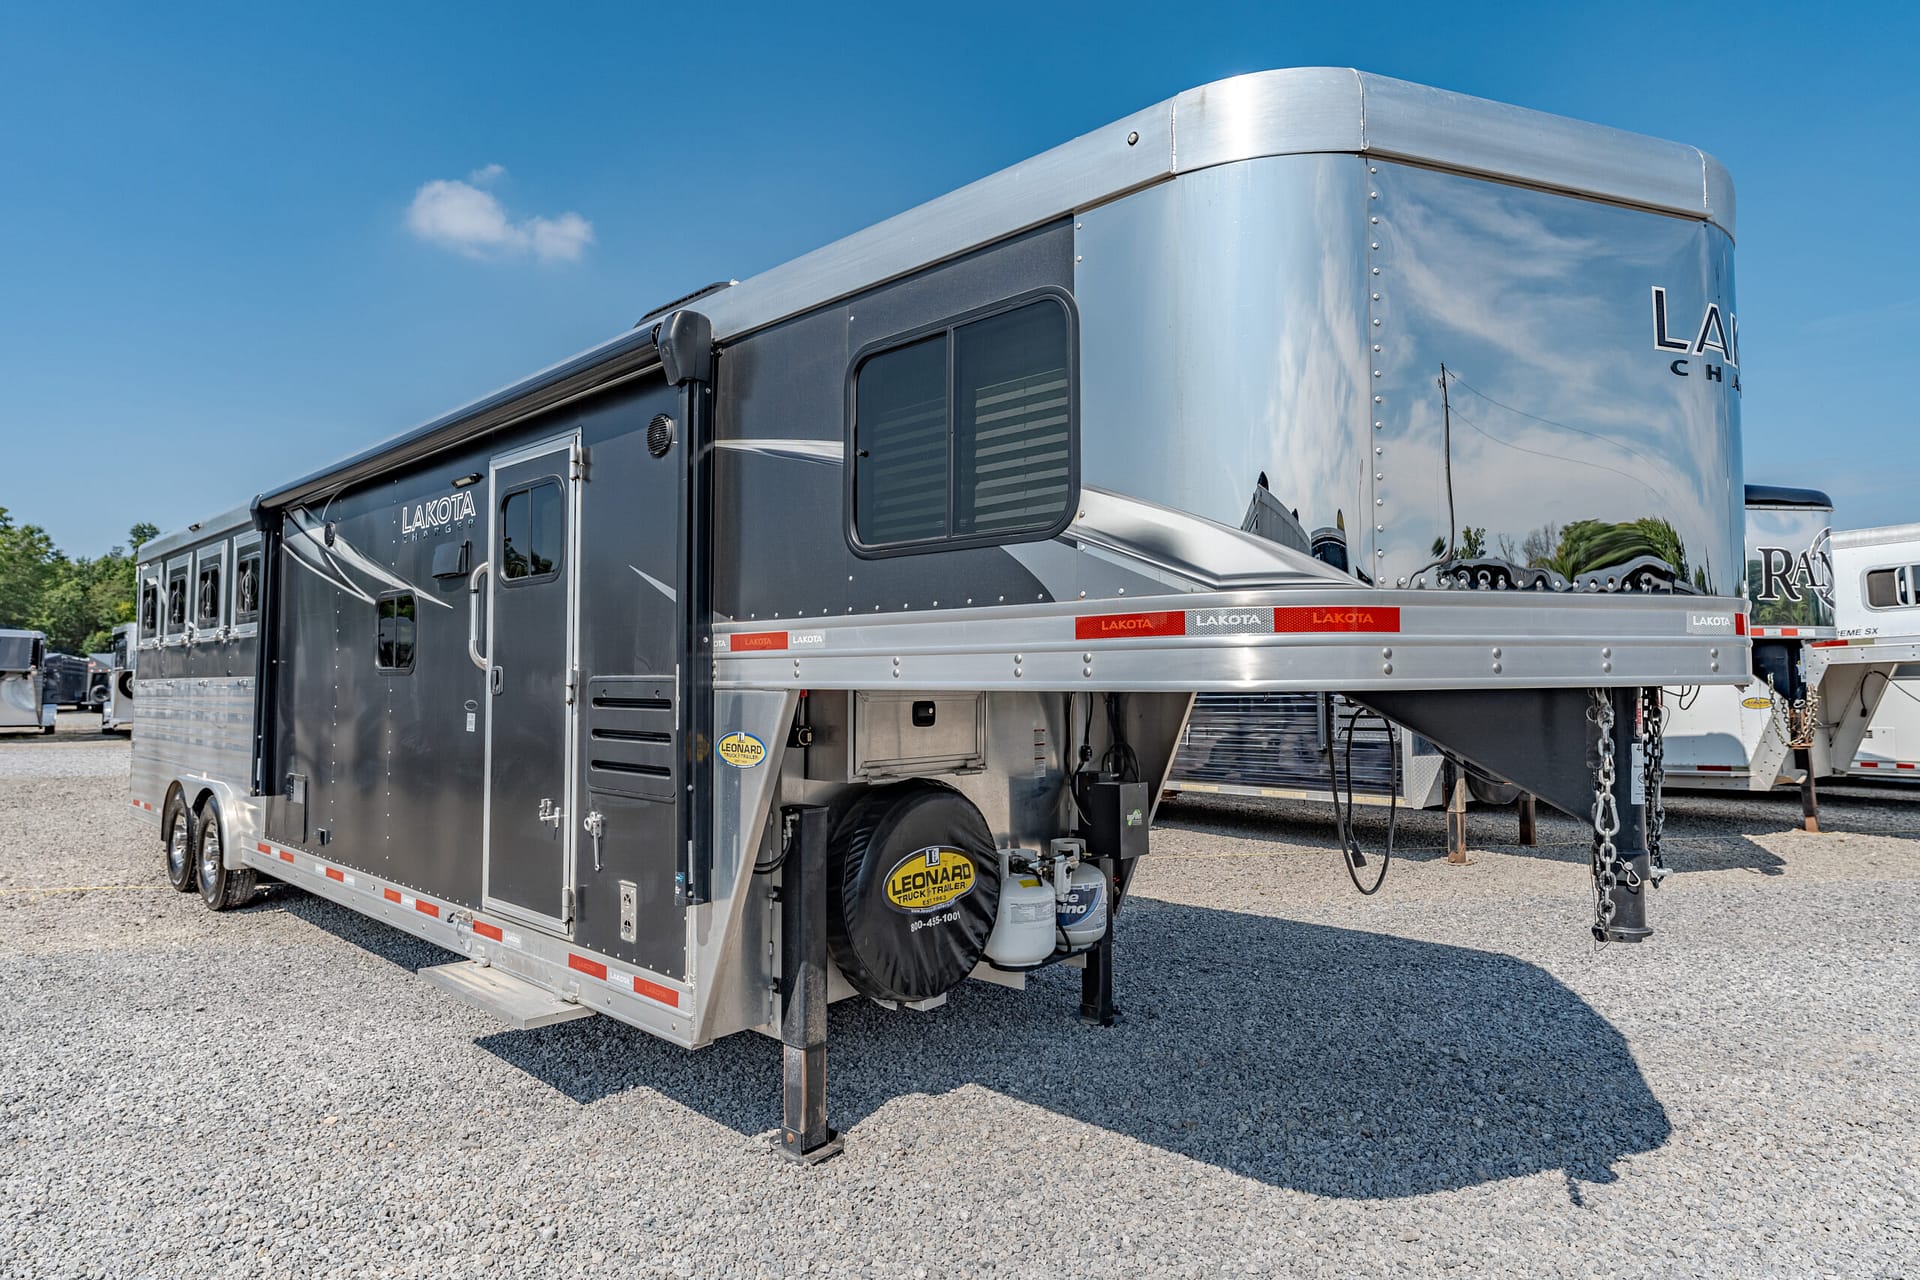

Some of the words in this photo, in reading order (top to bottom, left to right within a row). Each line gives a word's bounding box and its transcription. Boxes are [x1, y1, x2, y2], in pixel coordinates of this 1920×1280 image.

[402, 490, 477, 535] LAKOTA
[1101, 618, 1153, 631] LAKOTA
[1196, 613, 1262, 627] LAKOTA
[1312, 612, 1374, 625] LAKOTA
[1692, 615, 1731, 627] LAKOTA
[1864, 627, 1879, 636] SX
[744, 637, 772, 647] LAKOTA
[792, 635, 823, 644] LAKOTA
[721, 743, 762, 755] LEONARD
[892, 863, 971, 897] LEONARD
[897, 889, 926, 905] TRUCK
[932, 881, 966, 895] TRAILER
